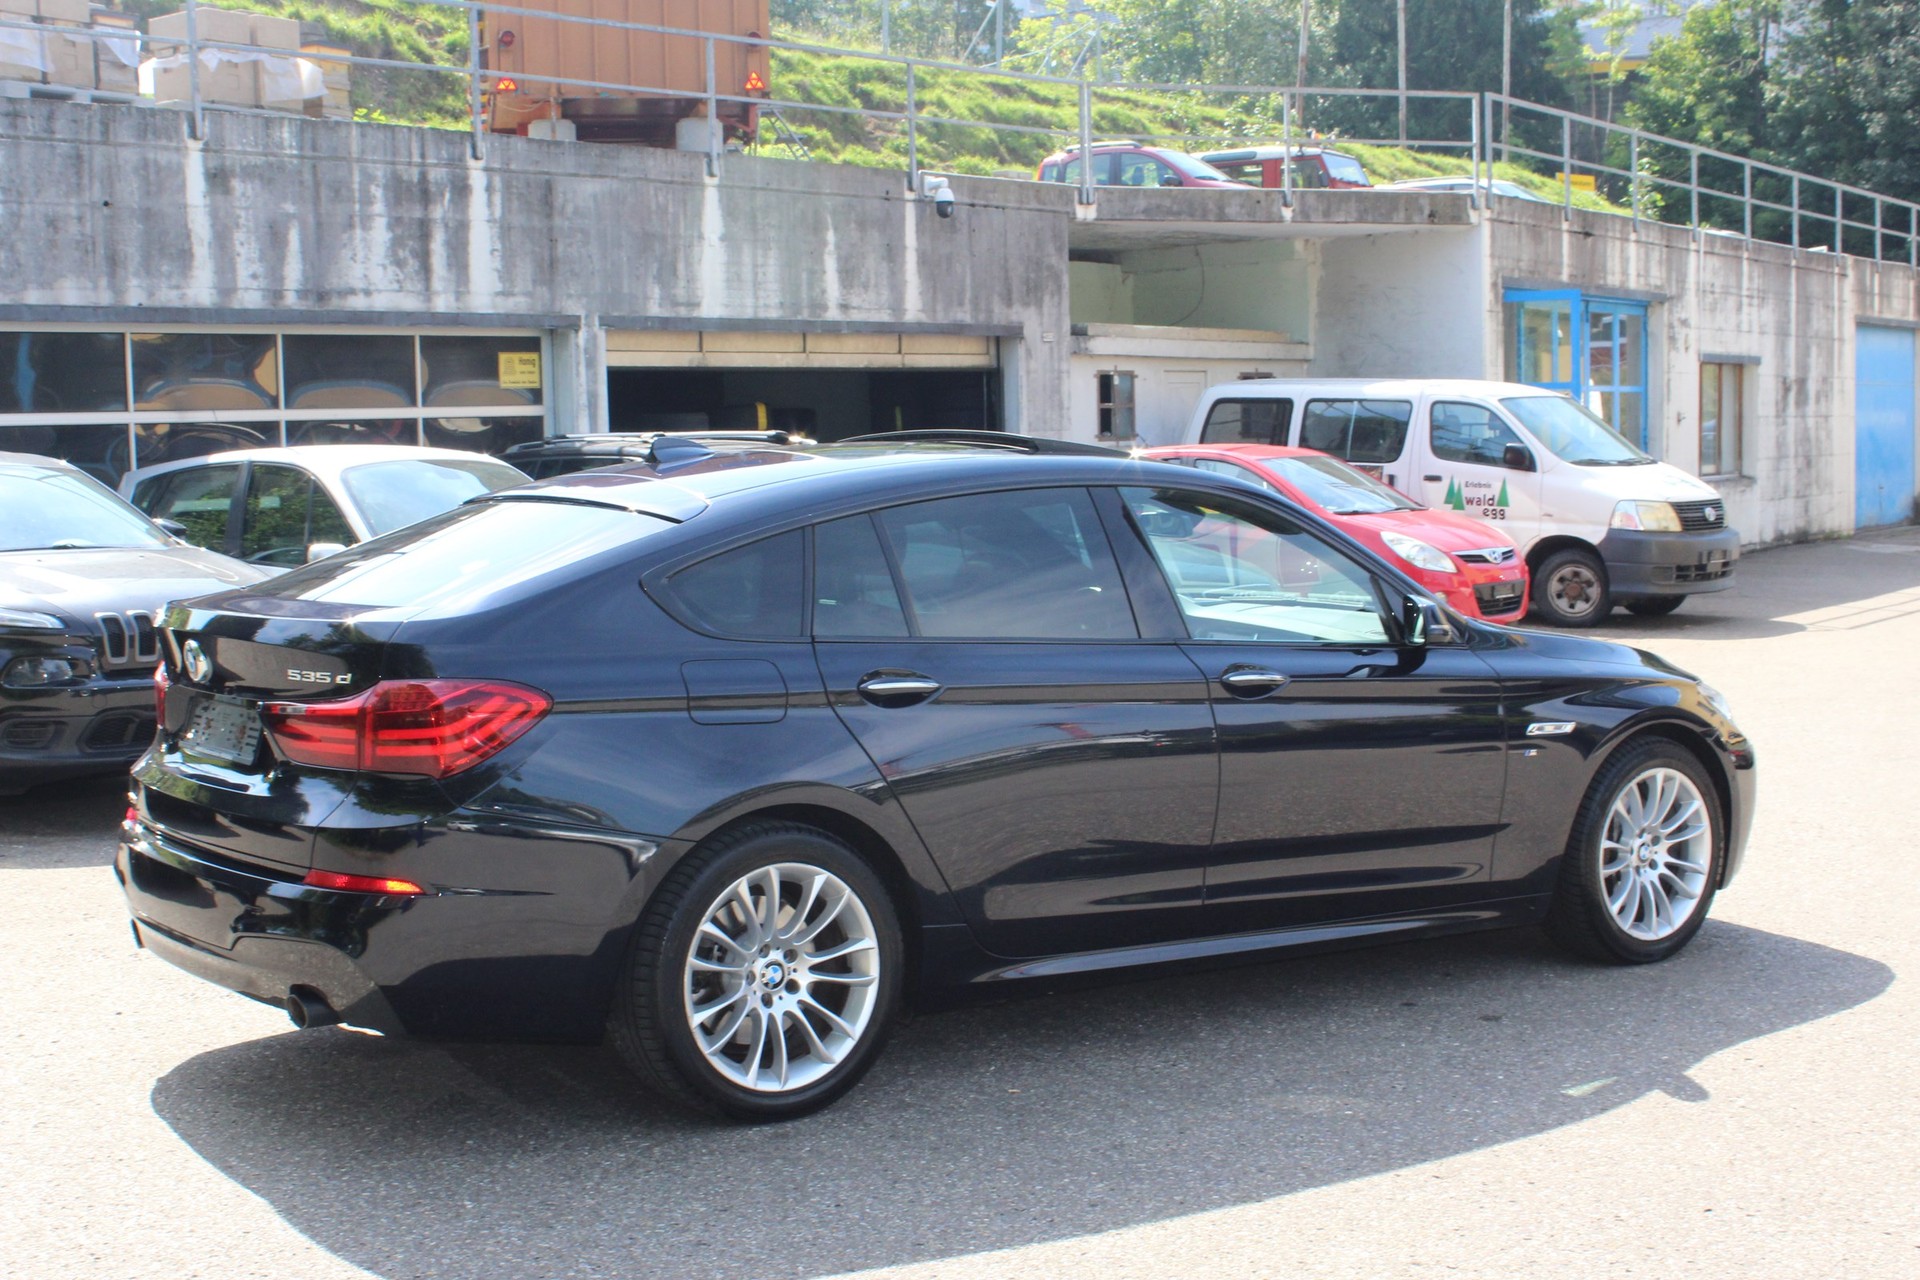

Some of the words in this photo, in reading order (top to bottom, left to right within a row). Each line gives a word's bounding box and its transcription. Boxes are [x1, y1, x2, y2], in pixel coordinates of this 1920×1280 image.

[1464, 494, 1495, 506] wald
[1482, 508, 1505, 520] egg
[287, 669, 331, 683] 535
[335, 673, 352, 684] d
